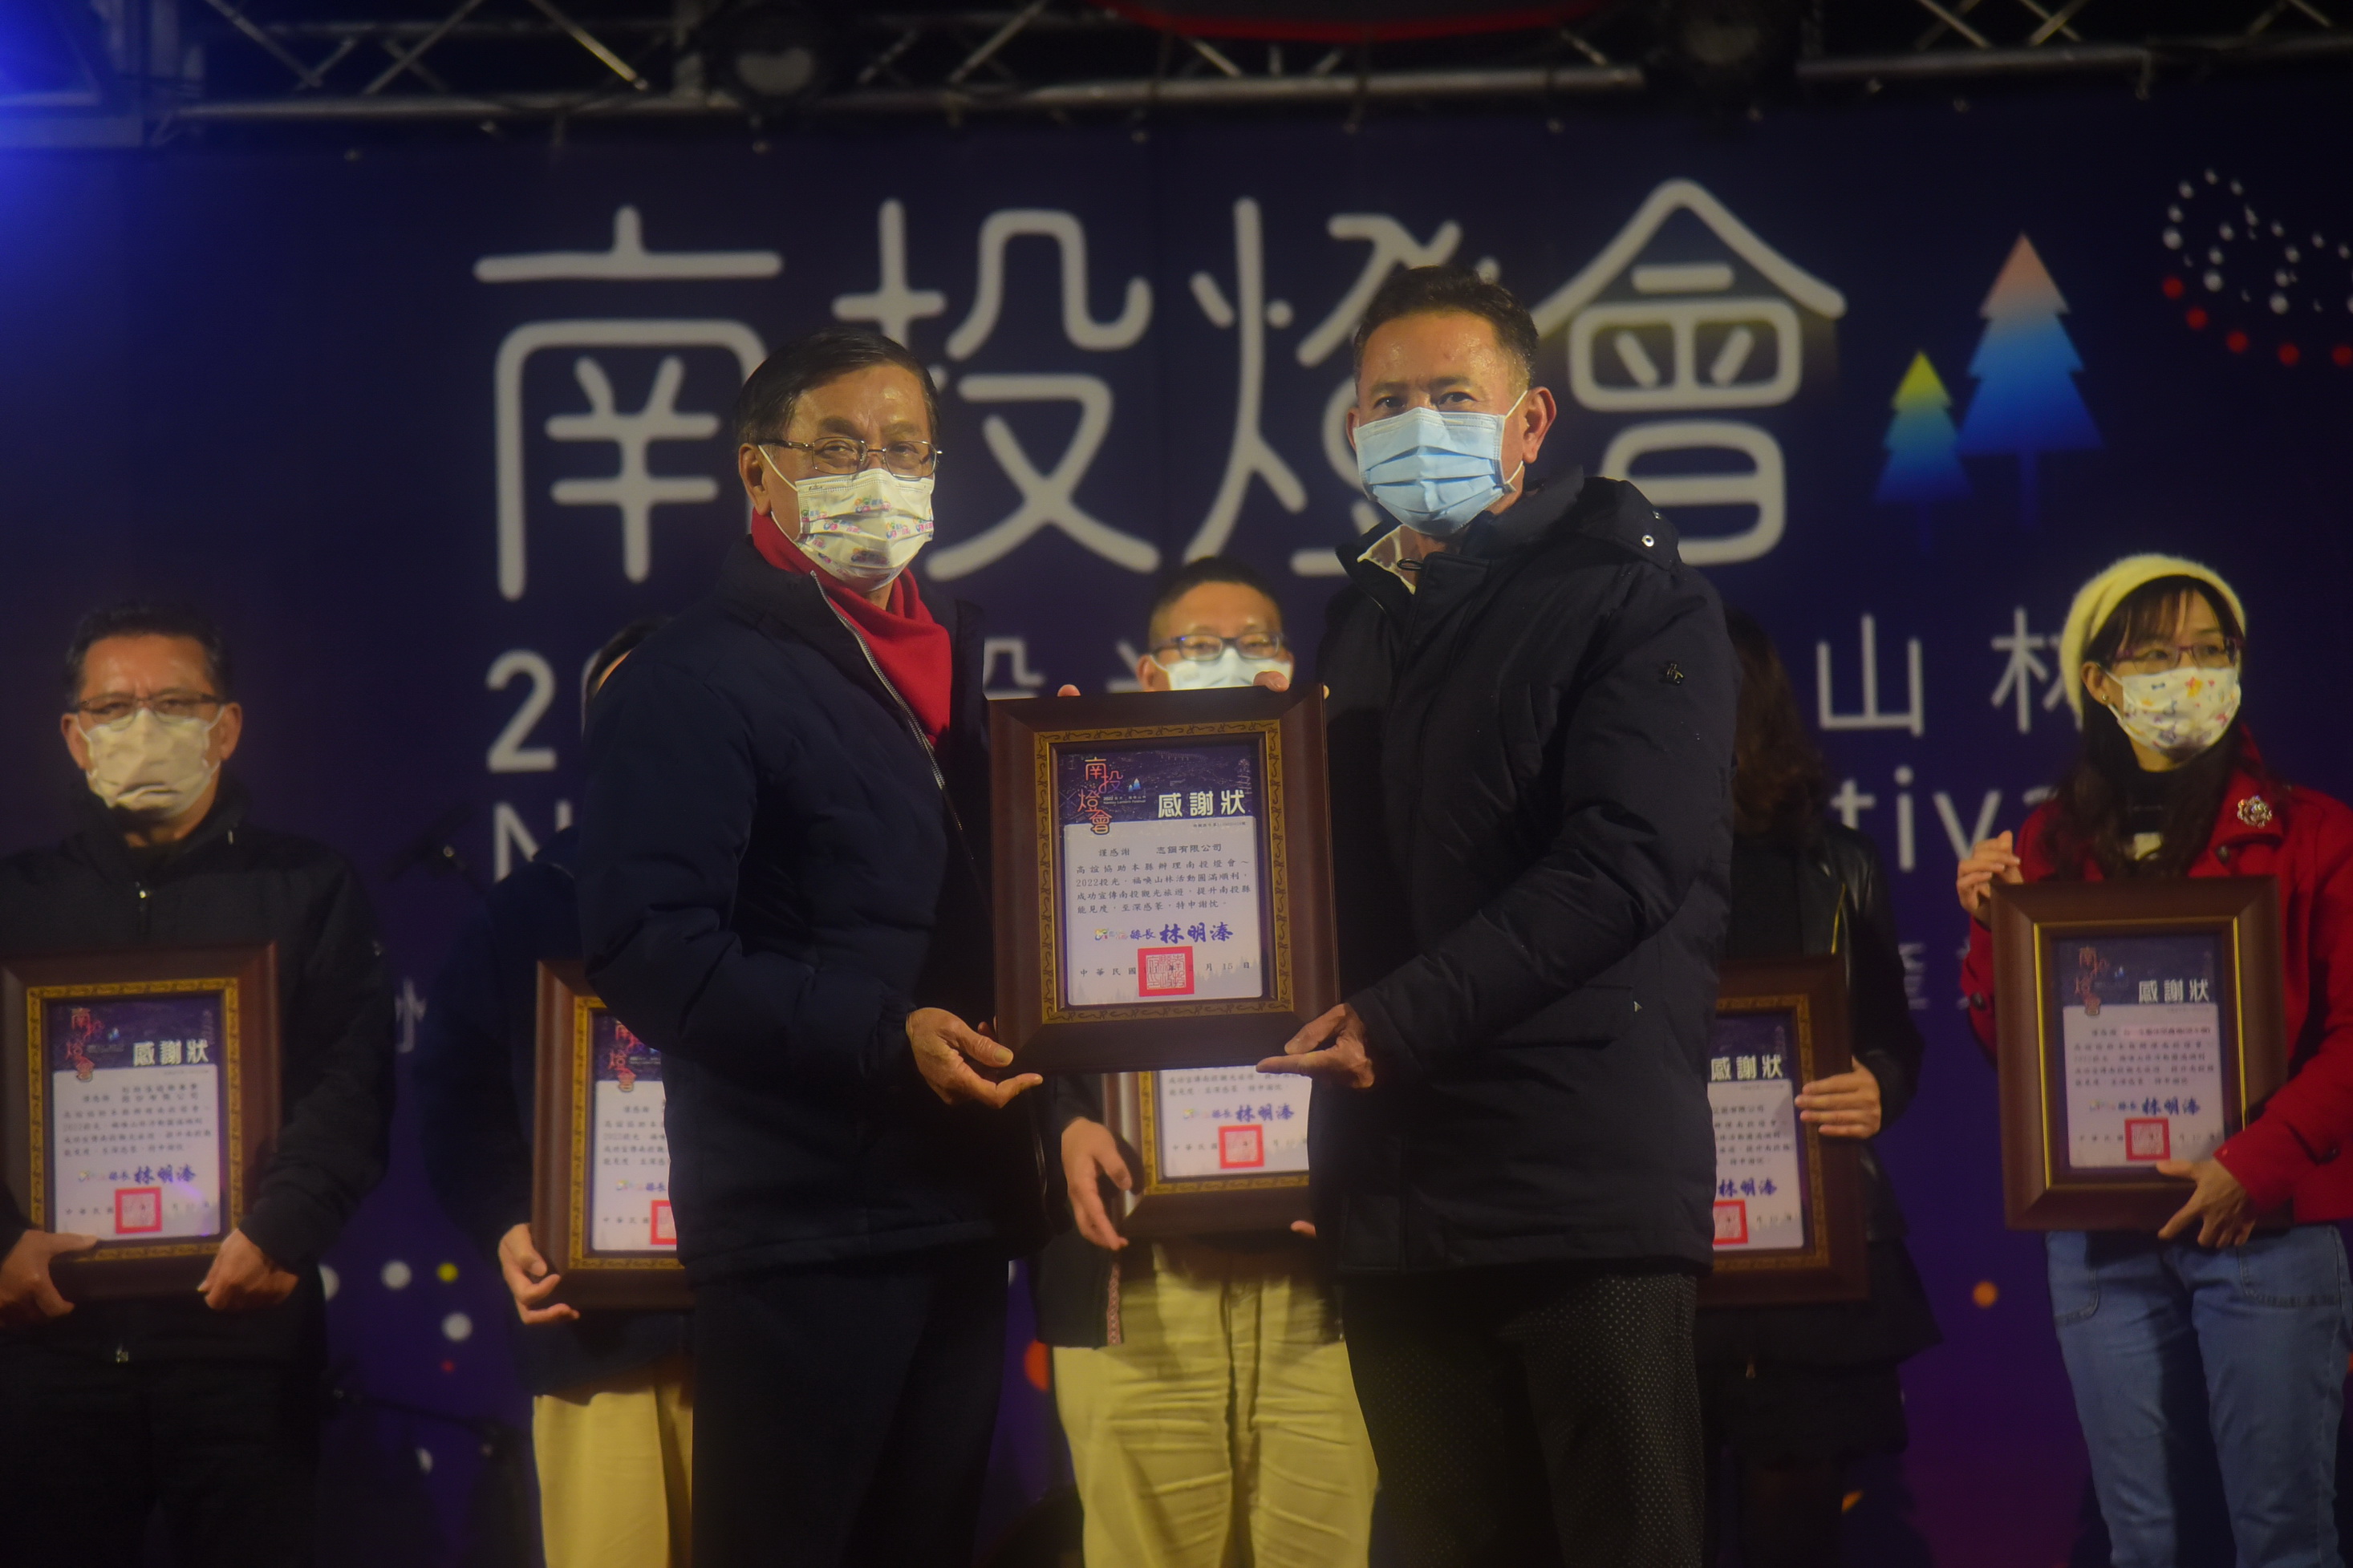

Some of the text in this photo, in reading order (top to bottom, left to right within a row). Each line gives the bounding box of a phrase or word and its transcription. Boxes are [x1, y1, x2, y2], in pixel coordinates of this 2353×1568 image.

[1158, 789, 1246, 818] 感謝狀
[2138, 978, 2209, 1004] 感謝狀
[133, 1039, 209, 1068] 感謝狀
[1711, 1054, 1783, 1081] 感謝狀
